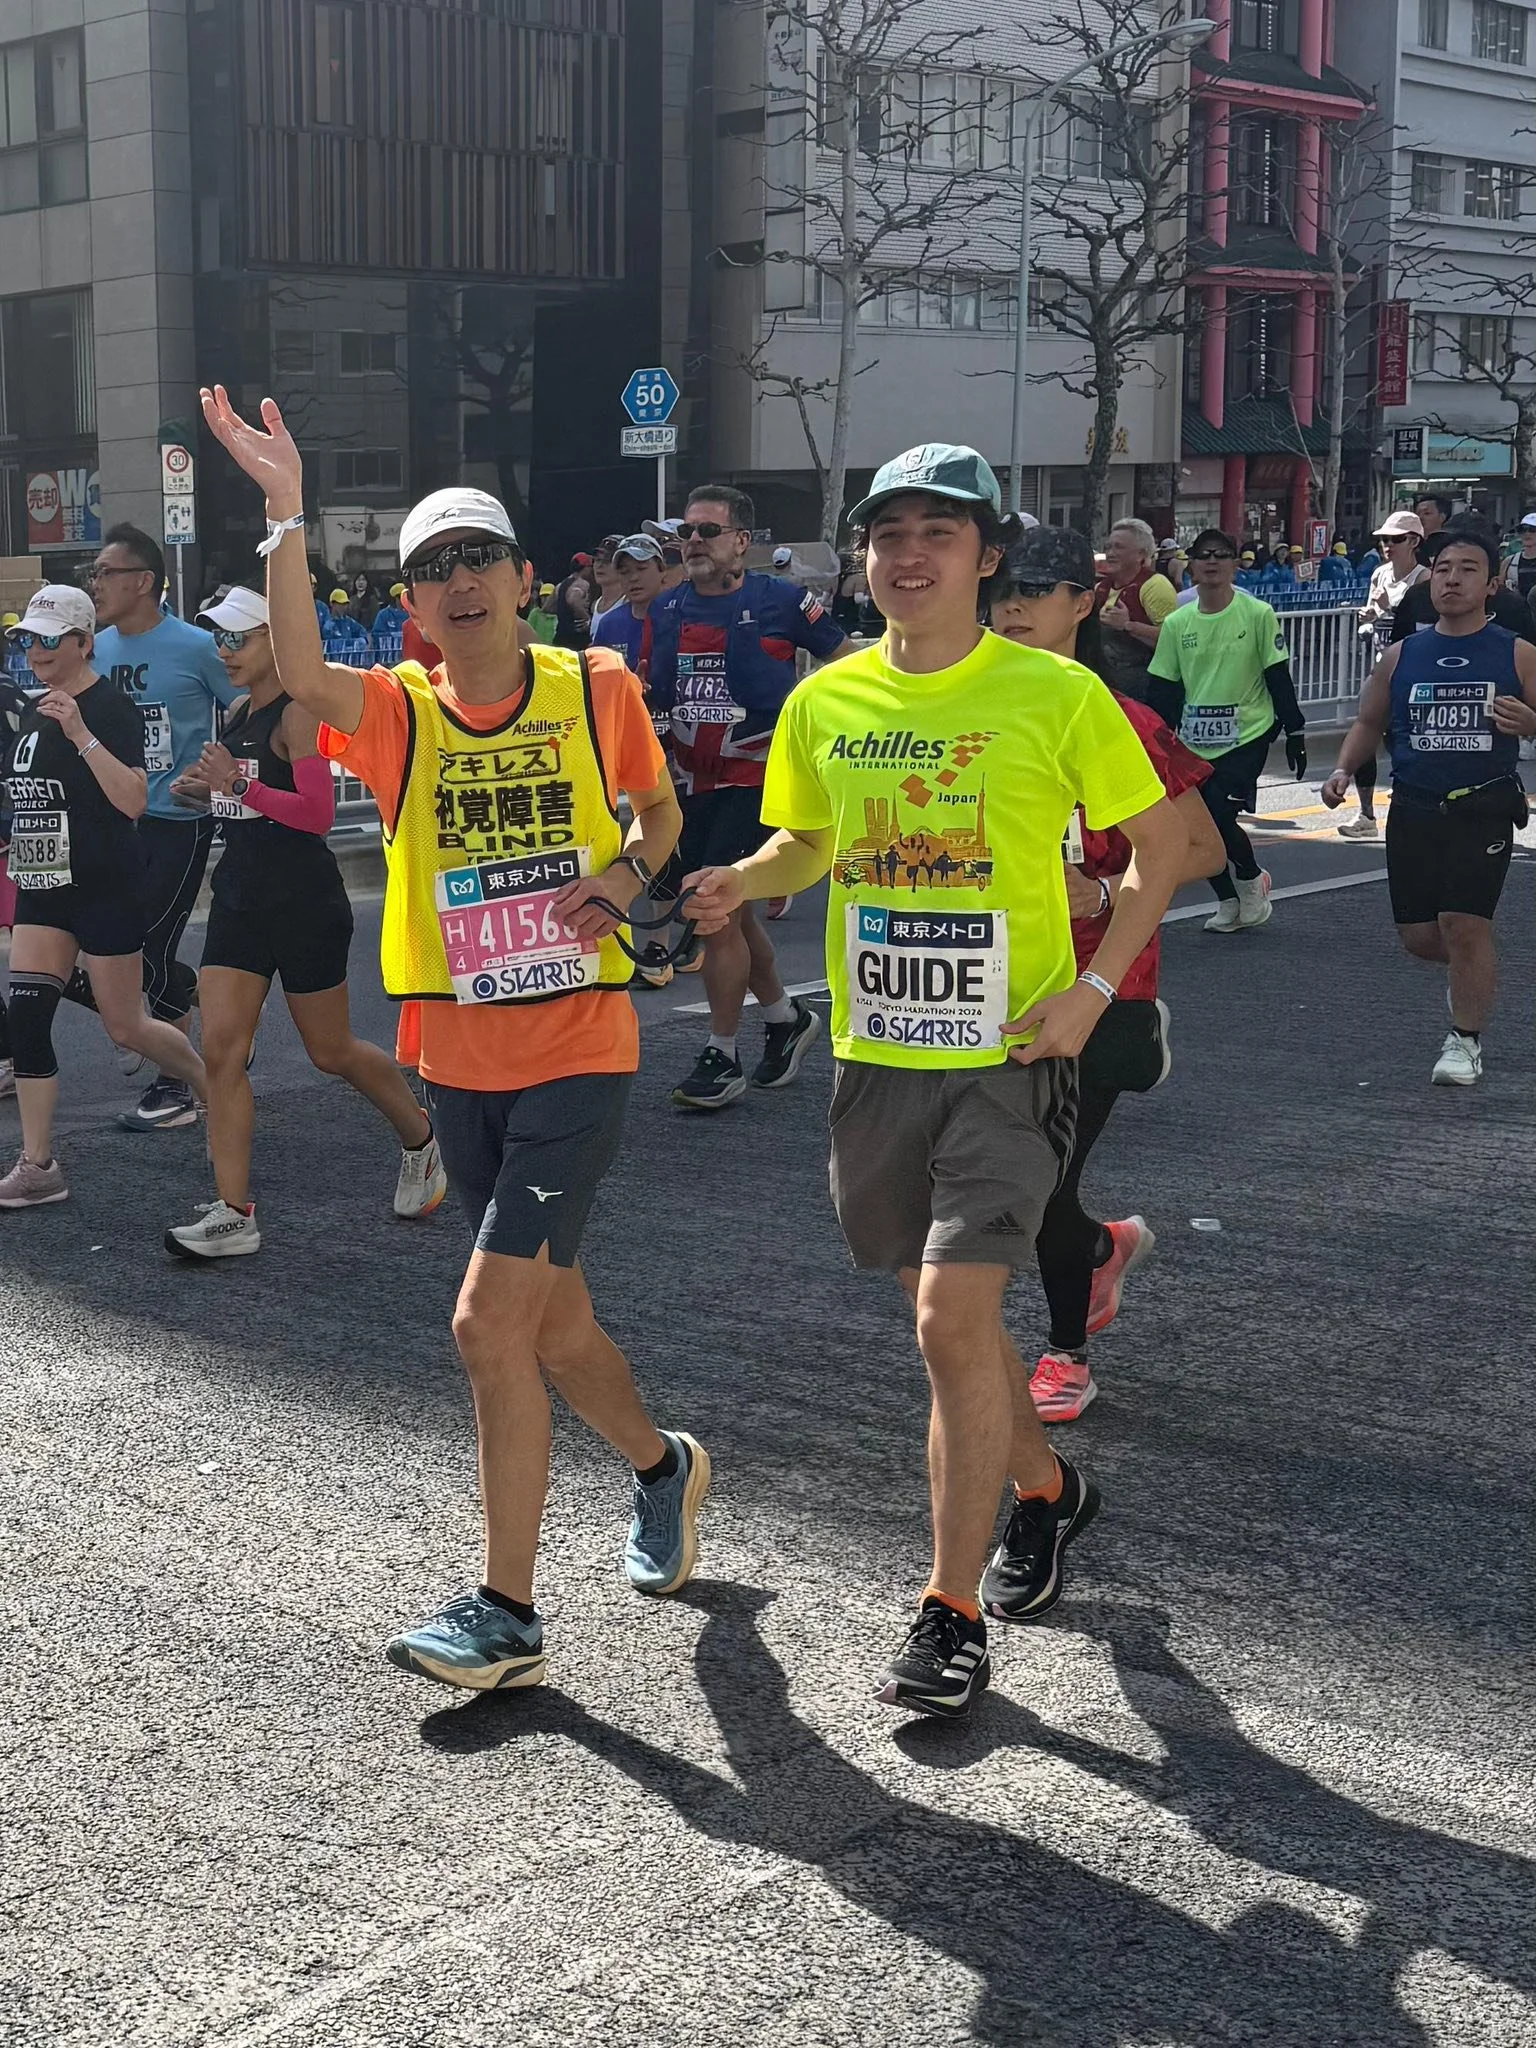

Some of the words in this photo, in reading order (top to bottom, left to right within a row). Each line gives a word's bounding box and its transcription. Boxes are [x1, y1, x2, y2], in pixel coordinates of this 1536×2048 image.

[635, 384, 665, 406] 50
[171, 455, 184, 466] 30
[684, 677, 729, 699] 4782
[1410, 708, 1420, 721] H
[1426, 705, 1478, 728] 40891
[512, 720, 562, 736] Achilles
[828, 731, 946, 760] Achilles
[849, 761, 940, 770] INTERNATIONAL
[938, 792, 977, 805] Japan
[487, 861, 575, 890] 東京メトロ
[446, 919, 466, 944] H
[893, 921, 985, 939] 東京メトロ
[456, 955, 467, 971] 4
[500, 958, 585, 995] STARTS
[857, 950, 985, 1003] GUIDE
[904, 1006, 956, 1016] MARATHON
[889, 1016, 982, 1047] STARTS
[204, 1219, 246, 1238] BROOKS
